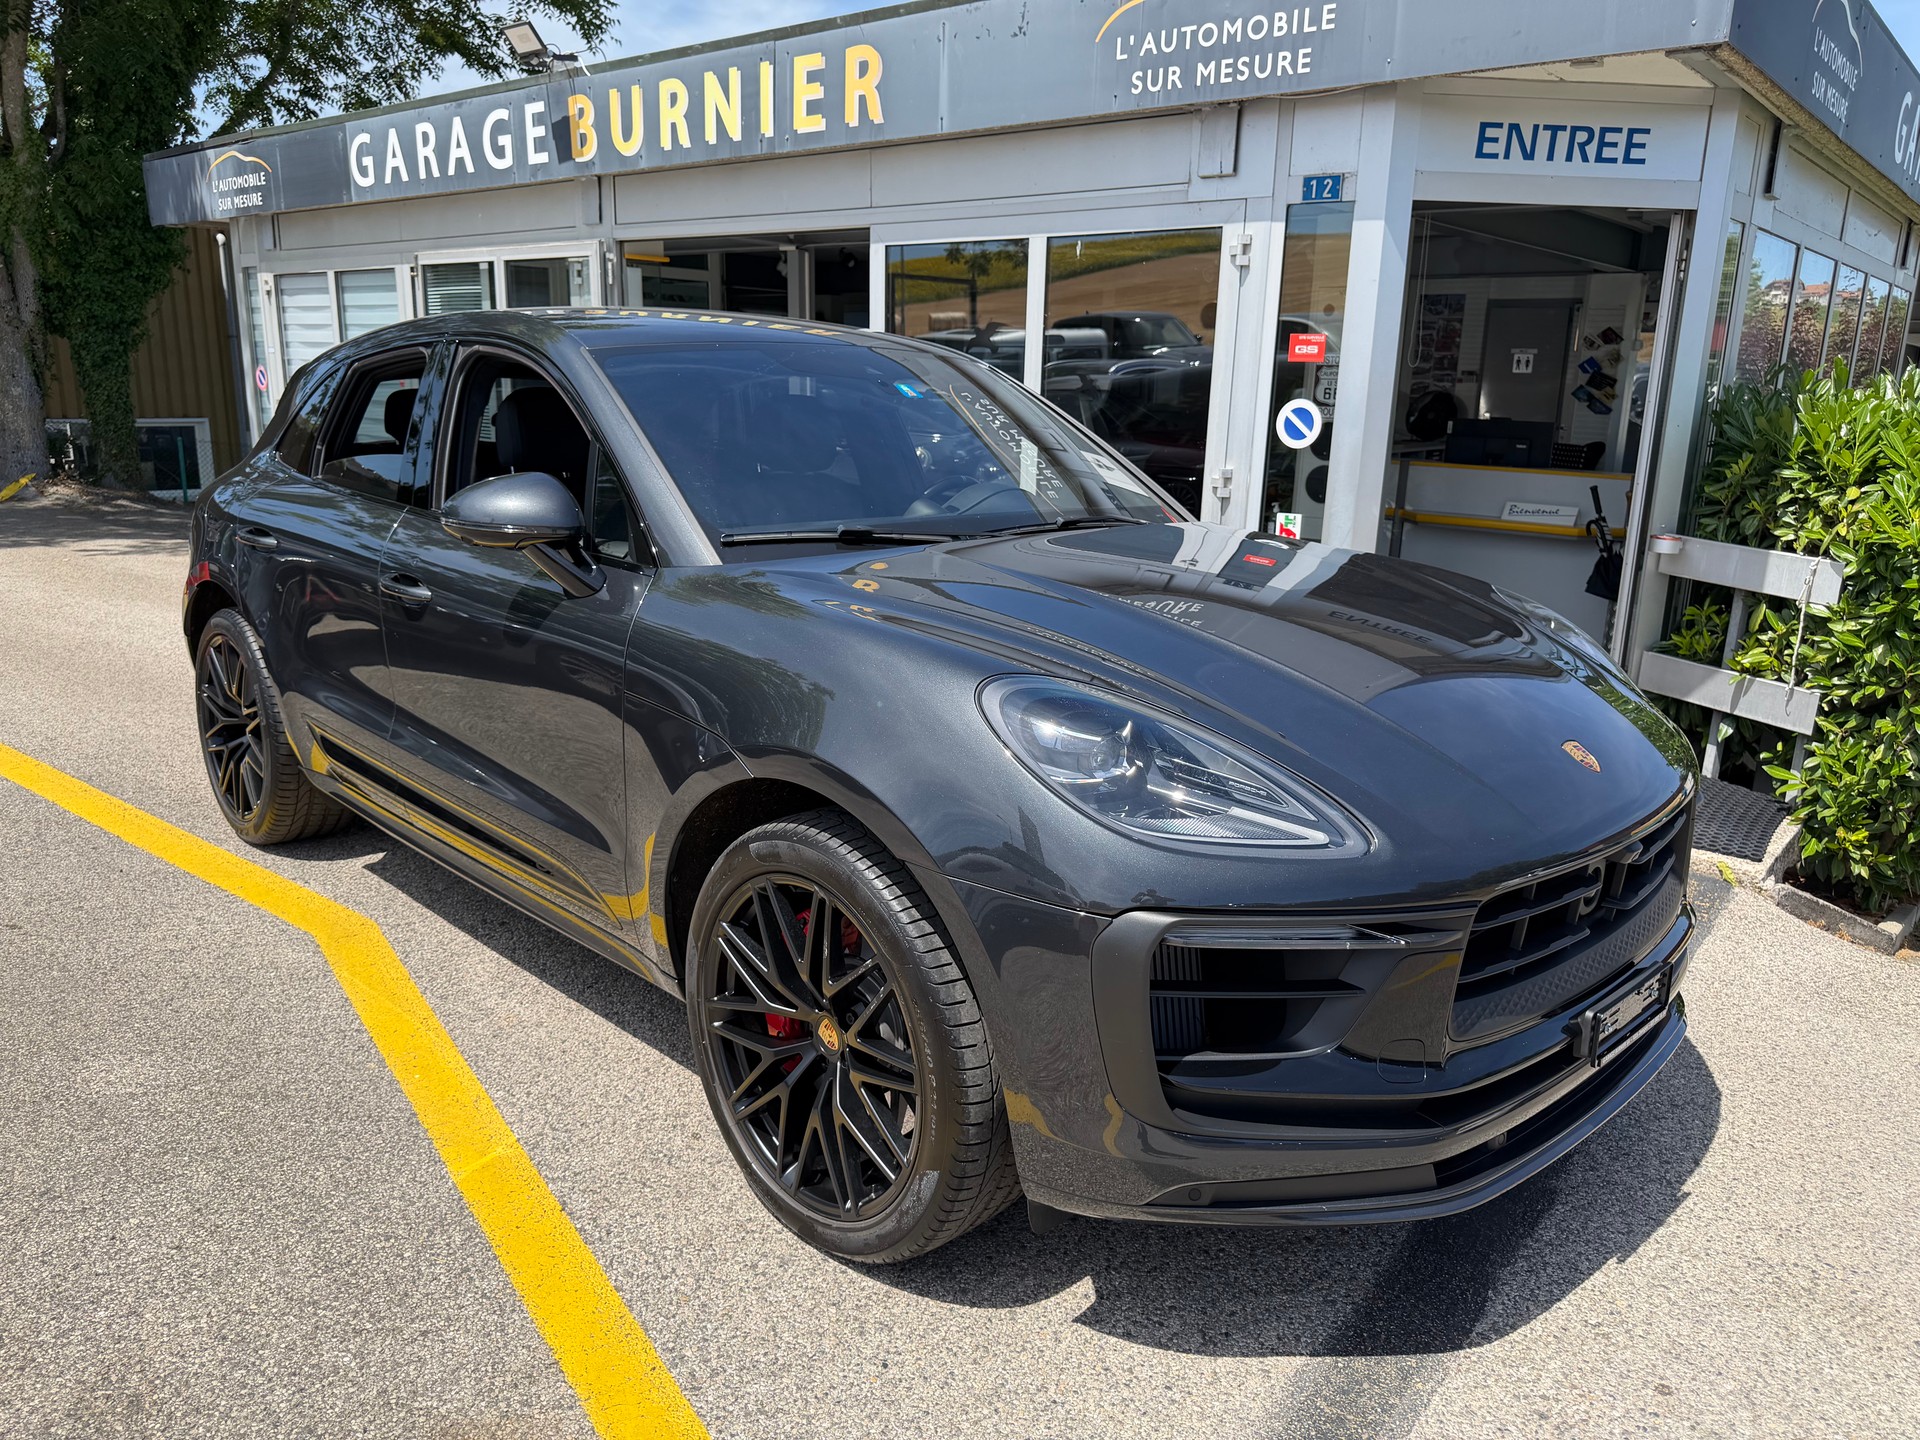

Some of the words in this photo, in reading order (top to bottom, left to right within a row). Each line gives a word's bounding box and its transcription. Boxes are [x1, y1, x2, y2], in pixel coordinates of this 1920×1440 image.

[1116, 3, 1337, 61] L'AUTOMOBILE
[1131, 65, 1183, 95] SUR
[1196, 47, 1312, 86] MESURE
[1814, 26, 1858, 92] L'AUTOMOBILE
[350, 100, 549, 188] GARAGE
[567, 44, 885, 163] BURNIER
[1812, 71, 1826, 104] SUR
[1825, 83, 1849, 124] MESURE
[1475, 121, 1652, 165] ENTREE
[1895, 91, 1920, 184] GA
[212, 171, 266, 193] L'AUTOMOBILE
[218, 197, 232, 211] SUR
[234, 192, 263, 209] MESURE
[1310, 180, 1333, 199] 12
[1295, 345, 1319, 354] GS
